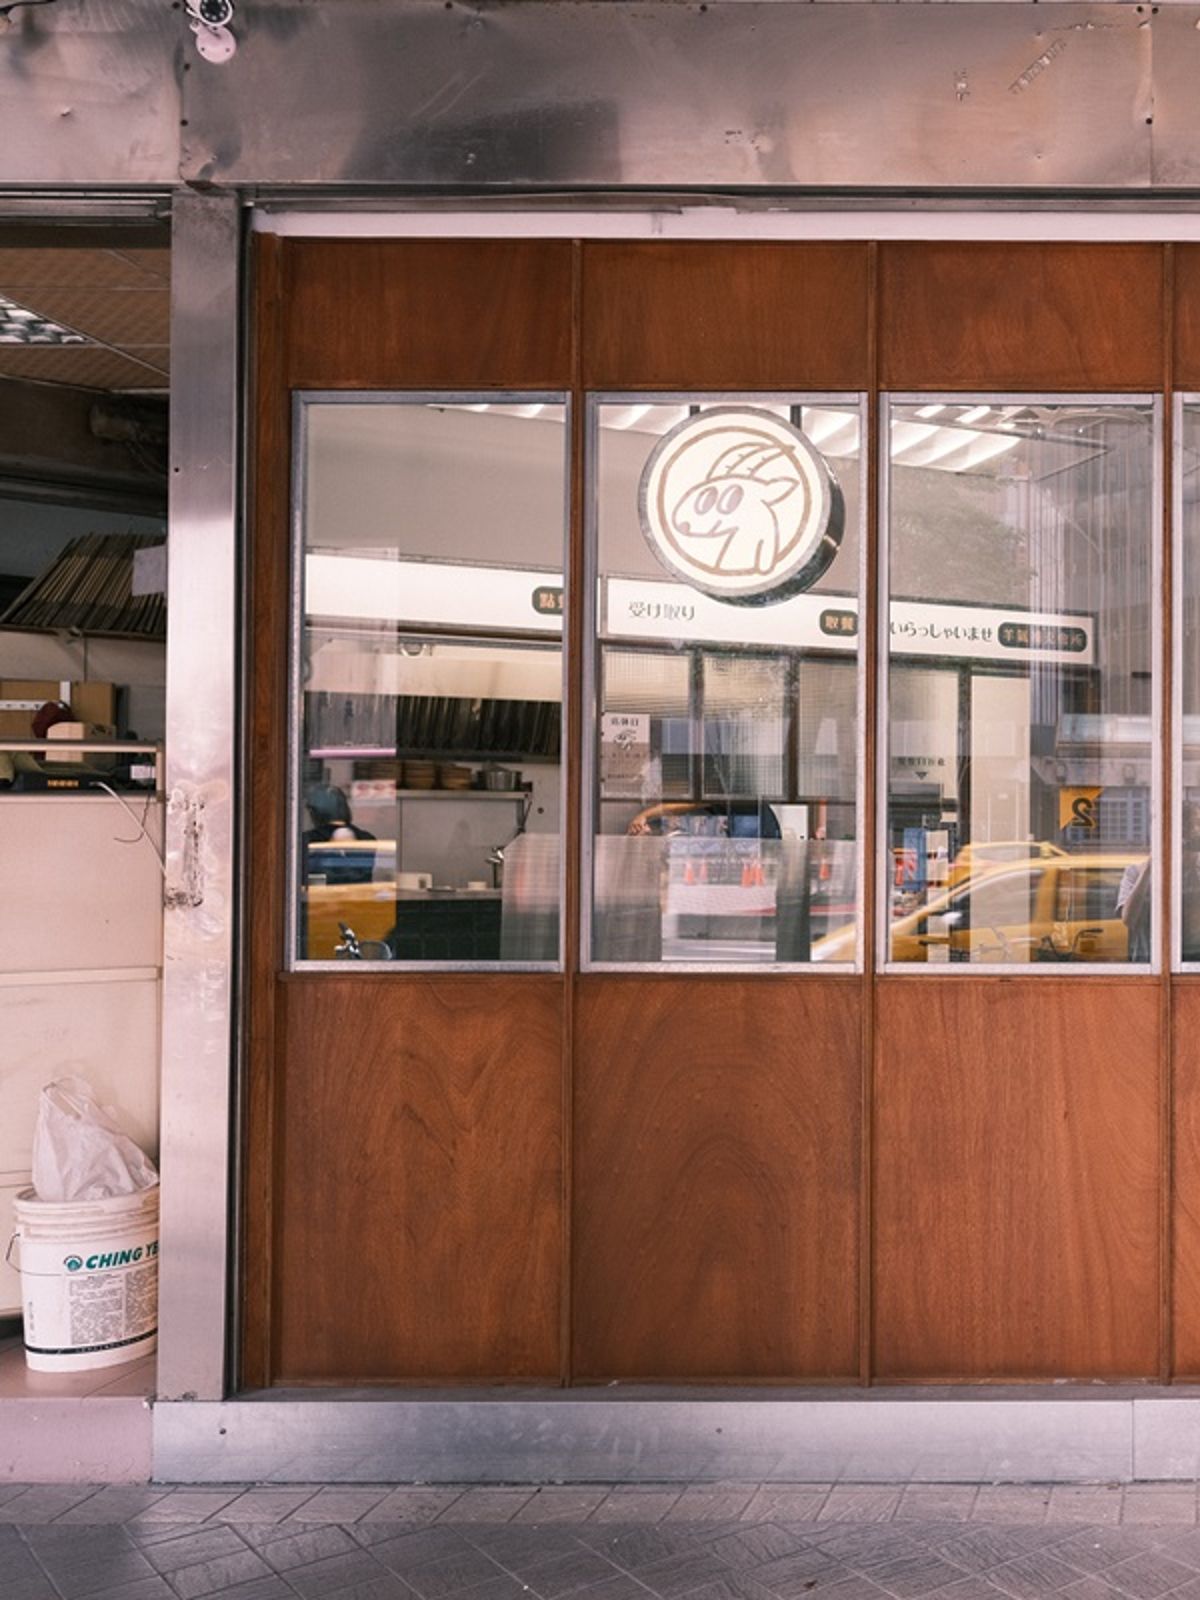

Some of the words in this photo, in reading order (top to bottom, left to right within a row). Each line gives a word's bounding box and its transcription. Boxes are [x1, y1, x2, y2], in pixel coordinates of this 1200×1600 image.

[629, 601, 696, 621] 受け取り
[890, 621, 993, 643] いらっしゃいませ
[86, 1247, 142, 1269] CHING
